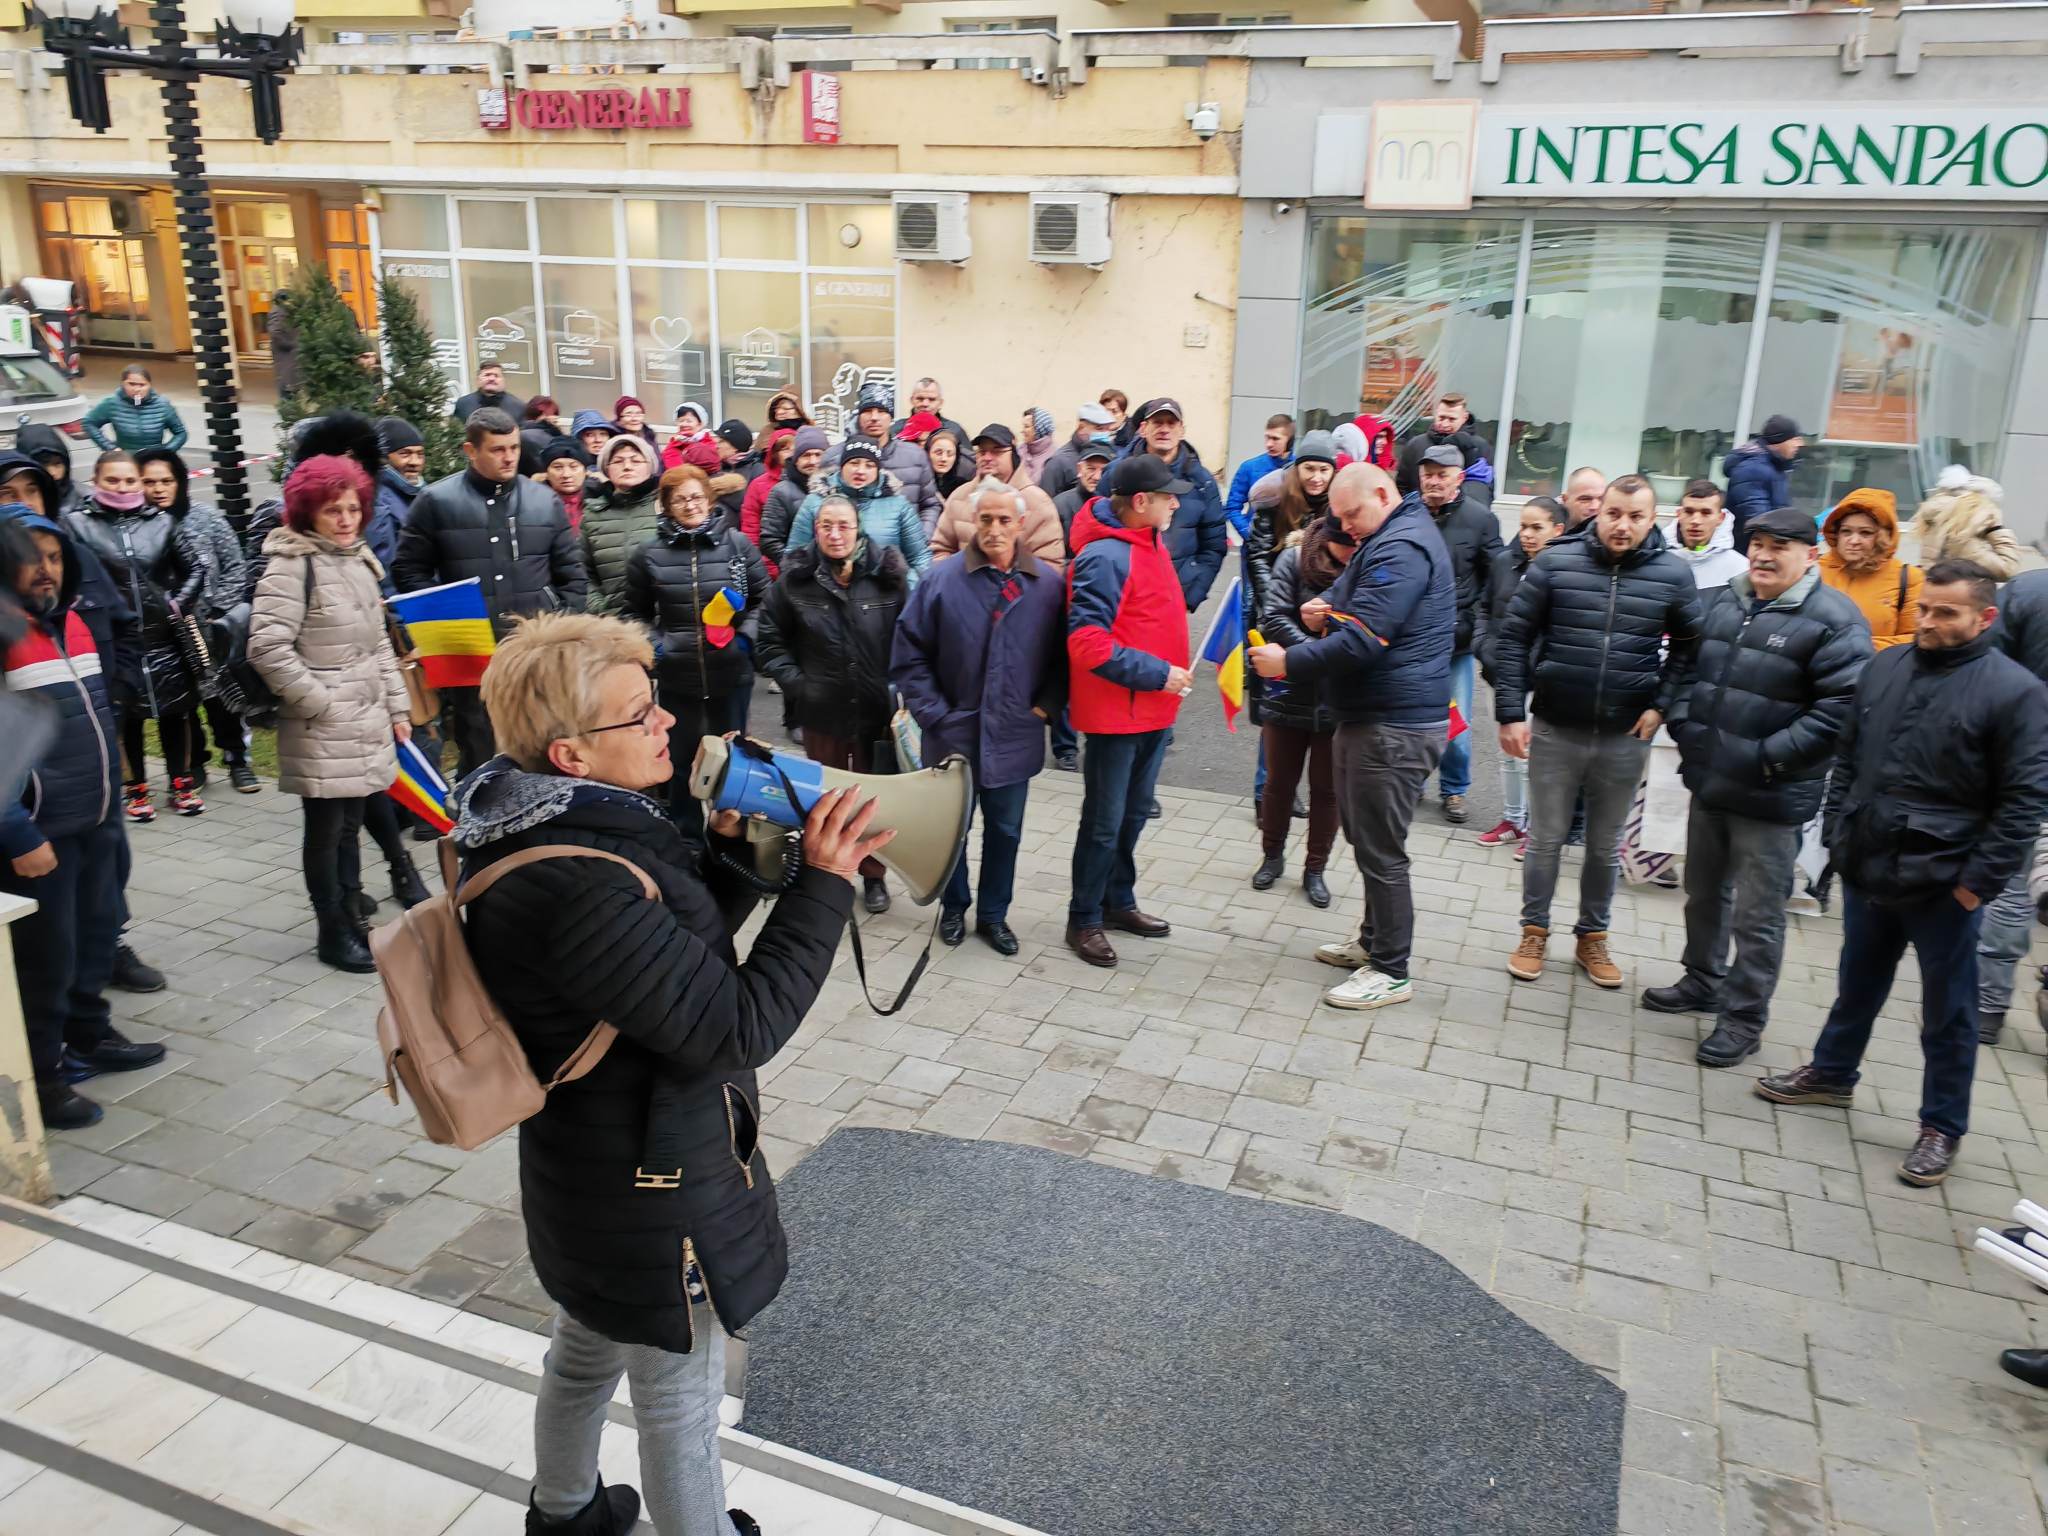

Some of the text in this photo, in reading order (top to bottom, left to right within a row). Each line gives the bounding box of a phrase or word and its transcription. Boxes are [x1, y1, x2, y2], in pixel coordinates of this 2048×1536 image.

[514, 86, 692, 129] GENERALI
[1501, 123, 2048, 187] INTESA SANPAO
